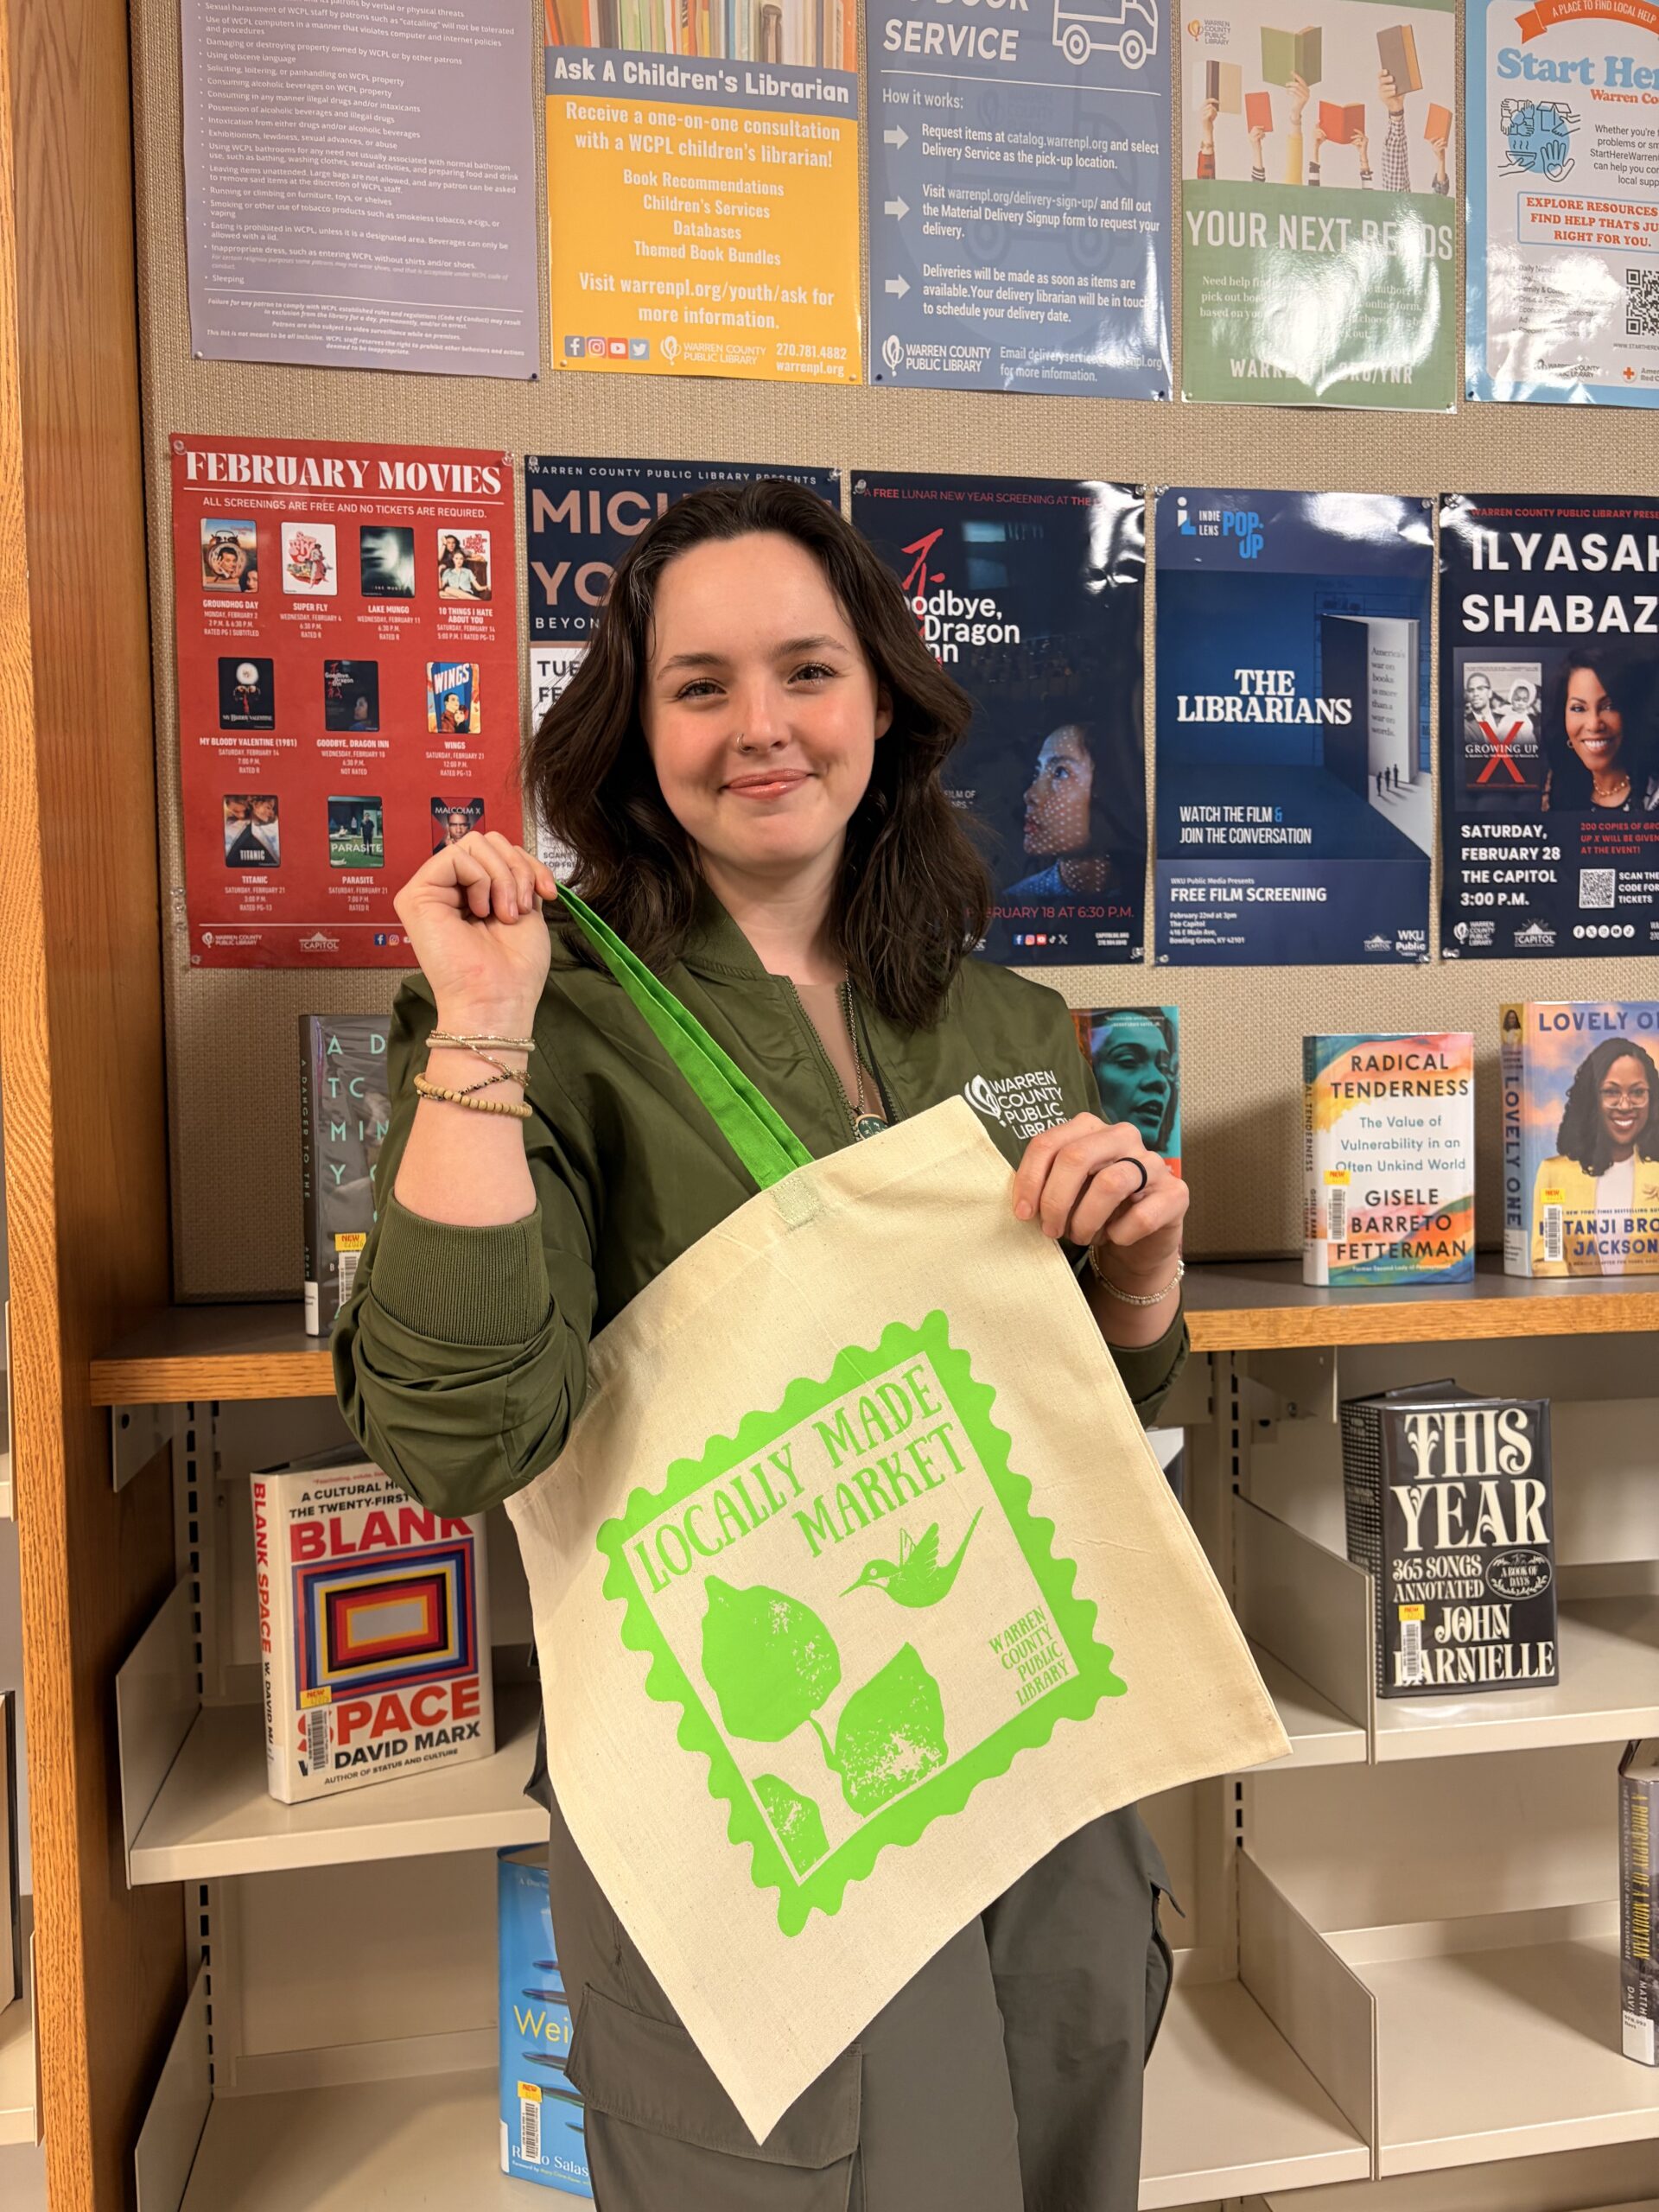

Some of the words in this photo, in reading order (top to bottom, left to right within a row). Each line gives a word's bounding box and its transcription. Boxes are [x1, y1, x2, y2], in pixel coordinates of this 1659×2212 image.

[1553, 9, 1559, 17] A
[1559, 2, 1581, 14] PLACE
[1585, 0, 1593, 10] TO
[1596, 0, 1611, 10] FIND
[1614, 3, 1636, 18] LOCAL
[1638, 10, 1657, 23] HELP
[883, 18, 1019, 61] SERVICE
[207, 51, 227, 61] Using
[230, 52, 260, 62] obscene
[263, 54, 296, 64] language
[1497, 48, 1595, 85] Start
[555, 57, 595, 81] Ask
[602, 60, 616, 83] A
[623, 61, 738, 93] Children's
[746, 73, 849, 104] Librarian
[882, 89, 908, 105] How
[912, 91, 921, 105] it
[925, 92, 963, 109] works:
[566, 102, 628, 124] Receive
[634, 109, 643, 124] a
[648, 109, 739, 132] one-on-one
[744, 119, 841, 142] consultation
[575, 132, 609, 150] with
[615, 138, 624, 151] a
[629, 135, 673, 155] WCPL
[678, 141, 756, 161] children's
[761, 147, 833, 168] librarian!
[623, 169, 658, 187] Book
[663, 172, 785, 196] Recommendations
[643, 195, 711, 214] Children's
[715, 200, 770, 219] Services
[1527, 197, 1583, 210] EXPLORE
[1586, 201, 1658, 216] RESOURCES
[673, 220, 741, 239] Databases
[922, 222, 965, 239] delivery.
[1185, 210, 1267, 248] YOUR
[1278, 213, 1352, 253] NEXT
[1554, 230, 1592, 242] RIGHT
[1597, 234, 1620, 245] FOR
[1624, 237, 1651, 246] YOU.
[634, 241, 686, 259] Themed
[690, 245, 724, 262] Book
[728, 247, 781, 265] Bundles
[213, 275, 245, 284] Sleeping
[579, 272, 615, 292] Visit
[620, 278, 807, 304] warrenpl.org/youth/ask
[812, 288, 835, 305] for
[638, 306, 679, 323] more
[683, 309, 779, 329] information.
[776, 343, 847, 359] 270.781.4882
[906, 344, 946, 359] WARREN
[950, 346, 991, 359] COUNTY
[776, 360, 844, 378] warrenpl.org
[906, 358, 940, 371] PUBLIC
[943, 359, 982, 372] LIBRARY
[187, 451, 370, 489] FEBRUARY
[379, 461, 501, 495] MOVIES
[203, 497, 221, 507] ALL
[225, 498, 286, 510] SCREENINGS
[289, 501, 307, 511] ARE
[310, 501, 334, 512] FREE
[337, 502, 358, 512] AND
[360, 504, 373, 513] NO
[376, 505, 414, 515] TICKETS
[416, 506, 435, 516] ARE
[438, 507, 486, 518] REQUIRED.
[1198, 511, 1220, 521] INDIE
[1198, 524, 1219, 536] LENS
[1239, 534, 1264, 559] UP
[293, 603, 314, 612] SUPER
[924, 615, 1020, 645] Dragon
[434, 664, 470, 694] WINGS
[1235, 670, 1295, 696] THE
[1177, 696, 1352, 725] LIBRARIANS
[435, 806, 474, 815] MALCOLM
[1179, 806, 1220, 823] WATCH
[1223, 806, 1244, 823] THE
[1246, 807, 1272, 823] FILM
[1179, 829, 1203, 843] JOIN
[1206, 828, 1227, 843] THE
[1229, 828, 1312, 844] CONVERSATION
[1461, 824, 1548, 841] SATURDAY,
[240, 849, 265, 861] TITANIC
[331, 843, 382, 854] PARASITE
[1461, 847, 1540, 861] FEBRUARY
[1542, 847, 1560, 861] 28
[342, 876, 373, 885] PARASITE
[1461, 869, 1491, 883] THE
[1494, 868, 1557, 884] CAPITOL
[1171, 888, 1205, 902] FREE
[1210, 888, 1243, 901] FILM
[1246, 888, 1327, 902] SCREENING
[1460, 892, 1493, 906] 3:00
[1497, 892, 1529, 906] P.M.
[1618, 895, 1653, 905] TICKETS
[1042, 907, 1054, 917] 18
[1058, 907, 1075, 918] AT
[1078, 906, 1105, 918] 6:30
[1108, 906, 1134, 918] P.M.
[1395, 941, 1426, 951] Public
[1397, 931, 1424, 941] WKU
[1539, 1013, 1628, 1032] LOVELY
[1351, 1053, 1448, 1071] RADICAL
[990, 1071, 1058, 1093] WARREN
[1331, 1079, 1469, 1099] TENDERNESS
[999, 1087, 1063, 1109] COUNTY
[1005, 1103, 1064, 1124] PUBLIC
[1359, 1117, 1382, 1128] The
[1387, 1116, 1424, 1128] Value
[1429, 1116, 1441, 1127] of
[1341, 1138, 1423, 1152] Vulnerability
[1428, 1138, 1440, 1149] in
[1444, 1139, 1460, 1149] an
[1335, 1160, 1372, 1173] Often
[1377, 1160, 1423, 1172] Unkind
[1428, 1159, 1465, 1170] World
[1365, 1189, 1439, 1206] GISELE
[1351, 1215, 1452, 1234] BARRETO
[1337, 1240, 1466, 1260] FETTERMAN
[1405, 1408, 1532, 1480] THIS
[633, 1443, 805, 1595] LOCALLY
[812, 1364, 942, 1468] MADE
[792, 1422, 966, 1557] MARKET
[302, 1492, 311, 1502] A
[315, 1482, 382, 1500] CULTURAL
[289, 1508, 315, 1518] THE
[319, 1493, 410, 1515] TWENTY-FIRST
[1390, 1478, 1550, 1552] YEAR
[289, 1505, 474, 1563] BLANK
[1392, 1557, 1423, 1580] 365
[1427, 1554, 1483, 1579] SONGS
[1393, 1579, 1484, 1603] ANNOTATED
[989, 1606, 1046, 1652] WARREN
[1434, 1604, 1512, 1643] JOHN
[1000, 1624, 1052, 1669] COUNTY
[1017, 1643, 1064, 1681] PUBLIC
[1015, 1660, 1070, 1707] LIBRARY
[334, 1738, 408, 1769] DAVID
[416, 1721, 481, 1751] MARX
